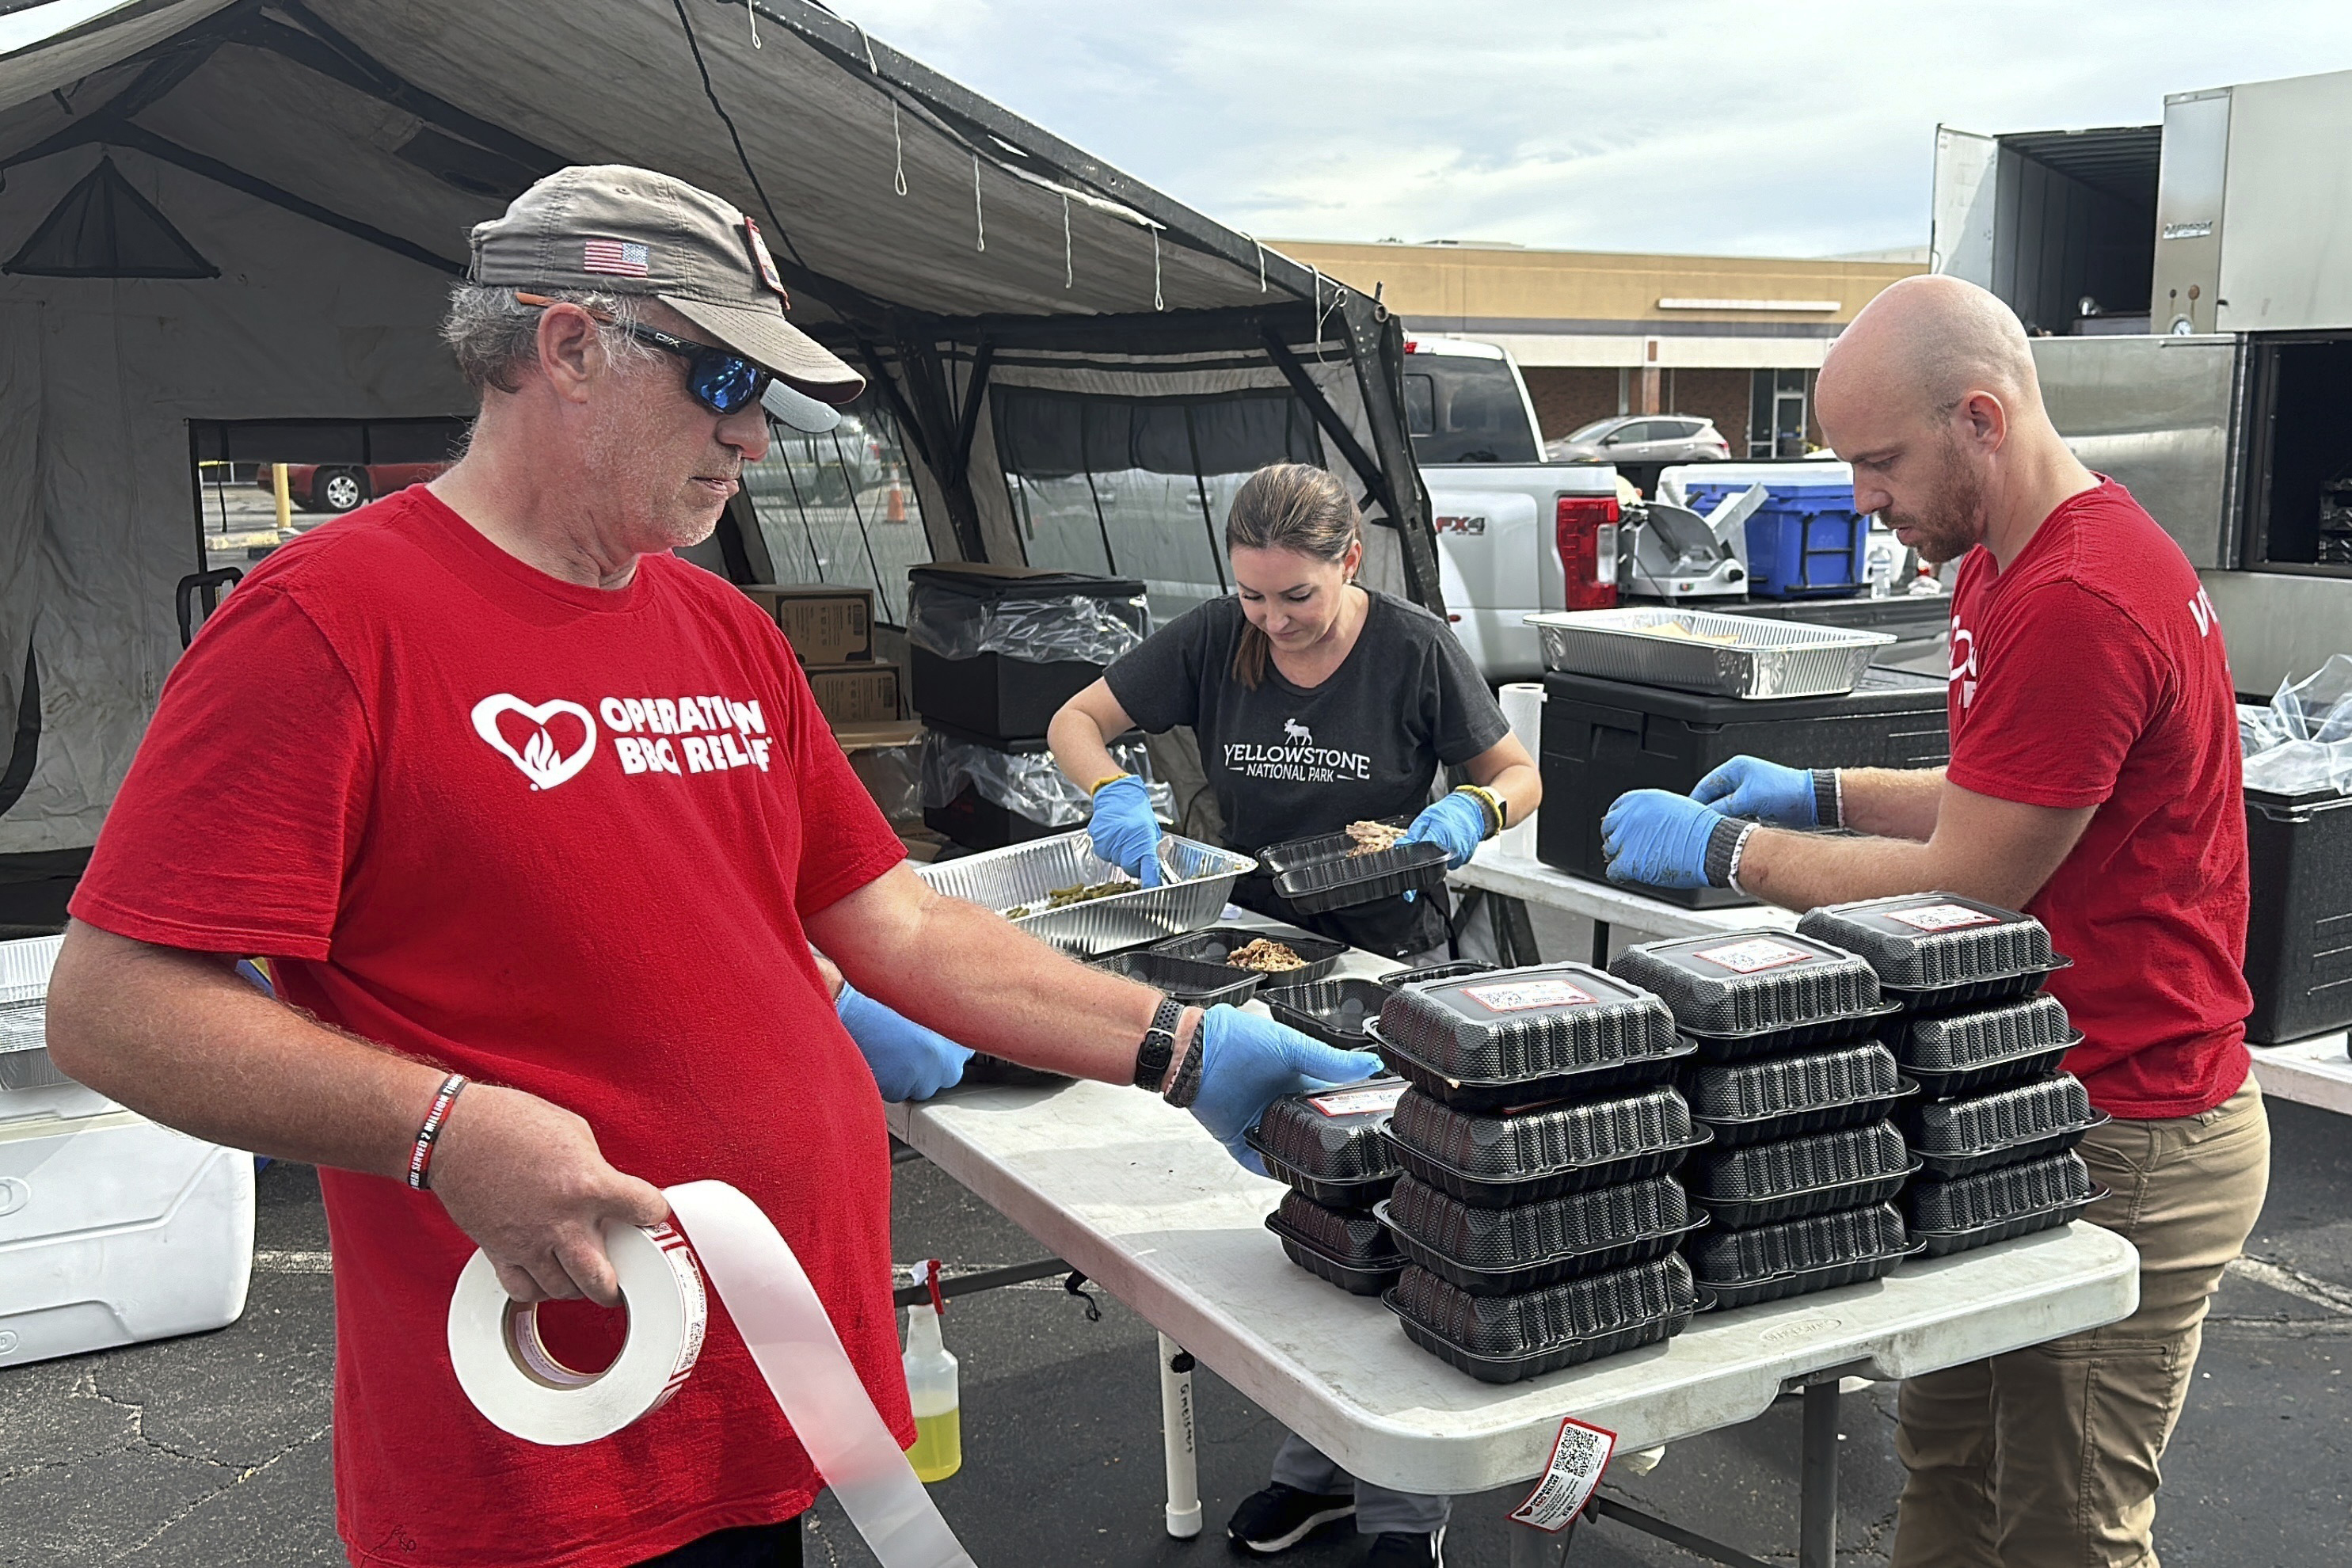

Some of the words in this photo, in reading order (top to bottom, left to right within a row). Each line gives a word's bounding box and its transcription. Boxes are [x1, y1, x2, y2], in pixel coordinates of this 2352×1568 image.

[1435, 516, 1486, 533] FX4
[599, 695, 767, 735] OPERATIN
[1224, 743, 1371, 780] YELLOWSTONE
[1246, 763, 1306, 782] NATIONAL
[1307, 767, 1335, 783] PARK
[424, 1094, 451, 1132] MILLION
[421, 1132, 431, 1141] 2
[411, 1140, 429, 1172] SERVED
[1531, 1474, 1555, 1505] OPERATION
[1545, 1476, 1559, 1495] RELIEF
